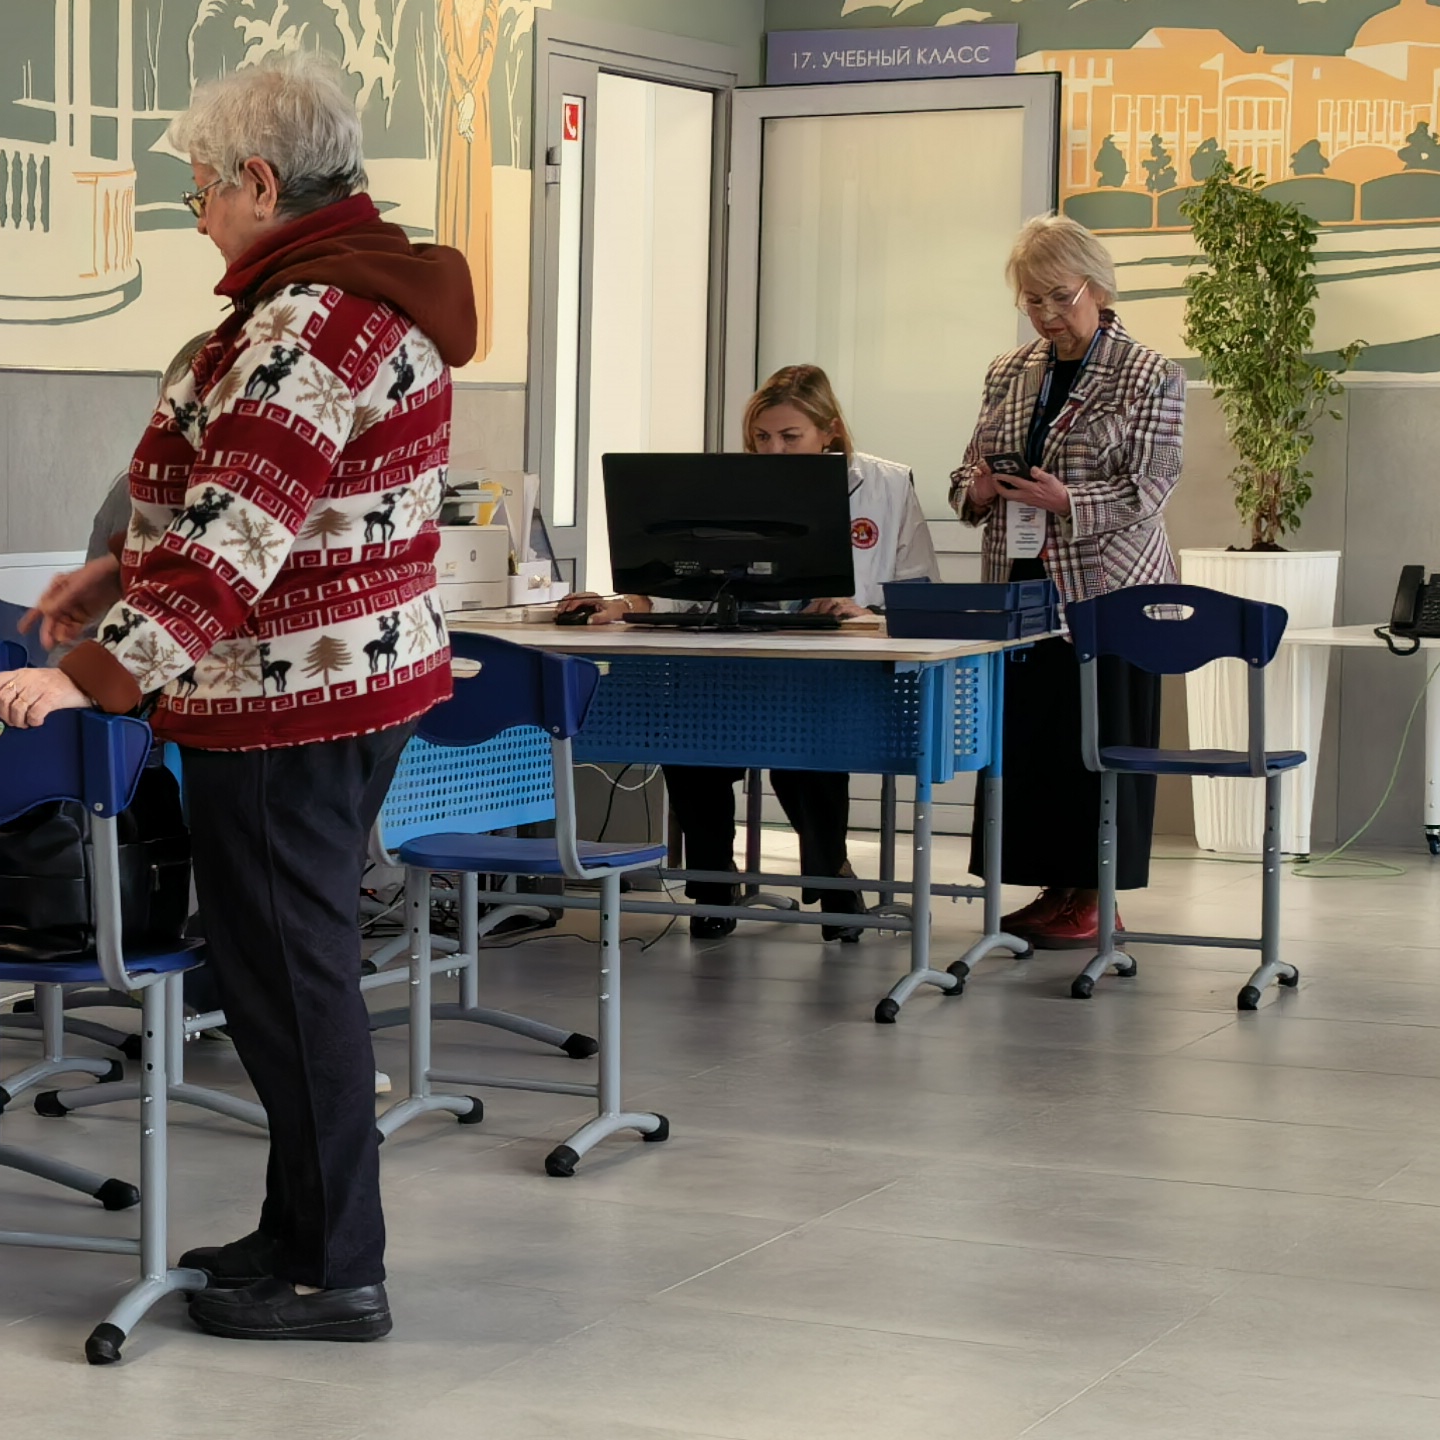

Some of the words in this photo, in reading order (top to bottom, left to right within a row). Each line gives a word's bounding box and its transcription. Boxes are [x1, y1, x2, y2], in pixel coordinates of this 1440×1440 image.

[791, 52, 816, 70] 17.
[822, 46, 911, 69] УЧЕБНЫЙ
[917, 45, 990, 65] КЛАСС
